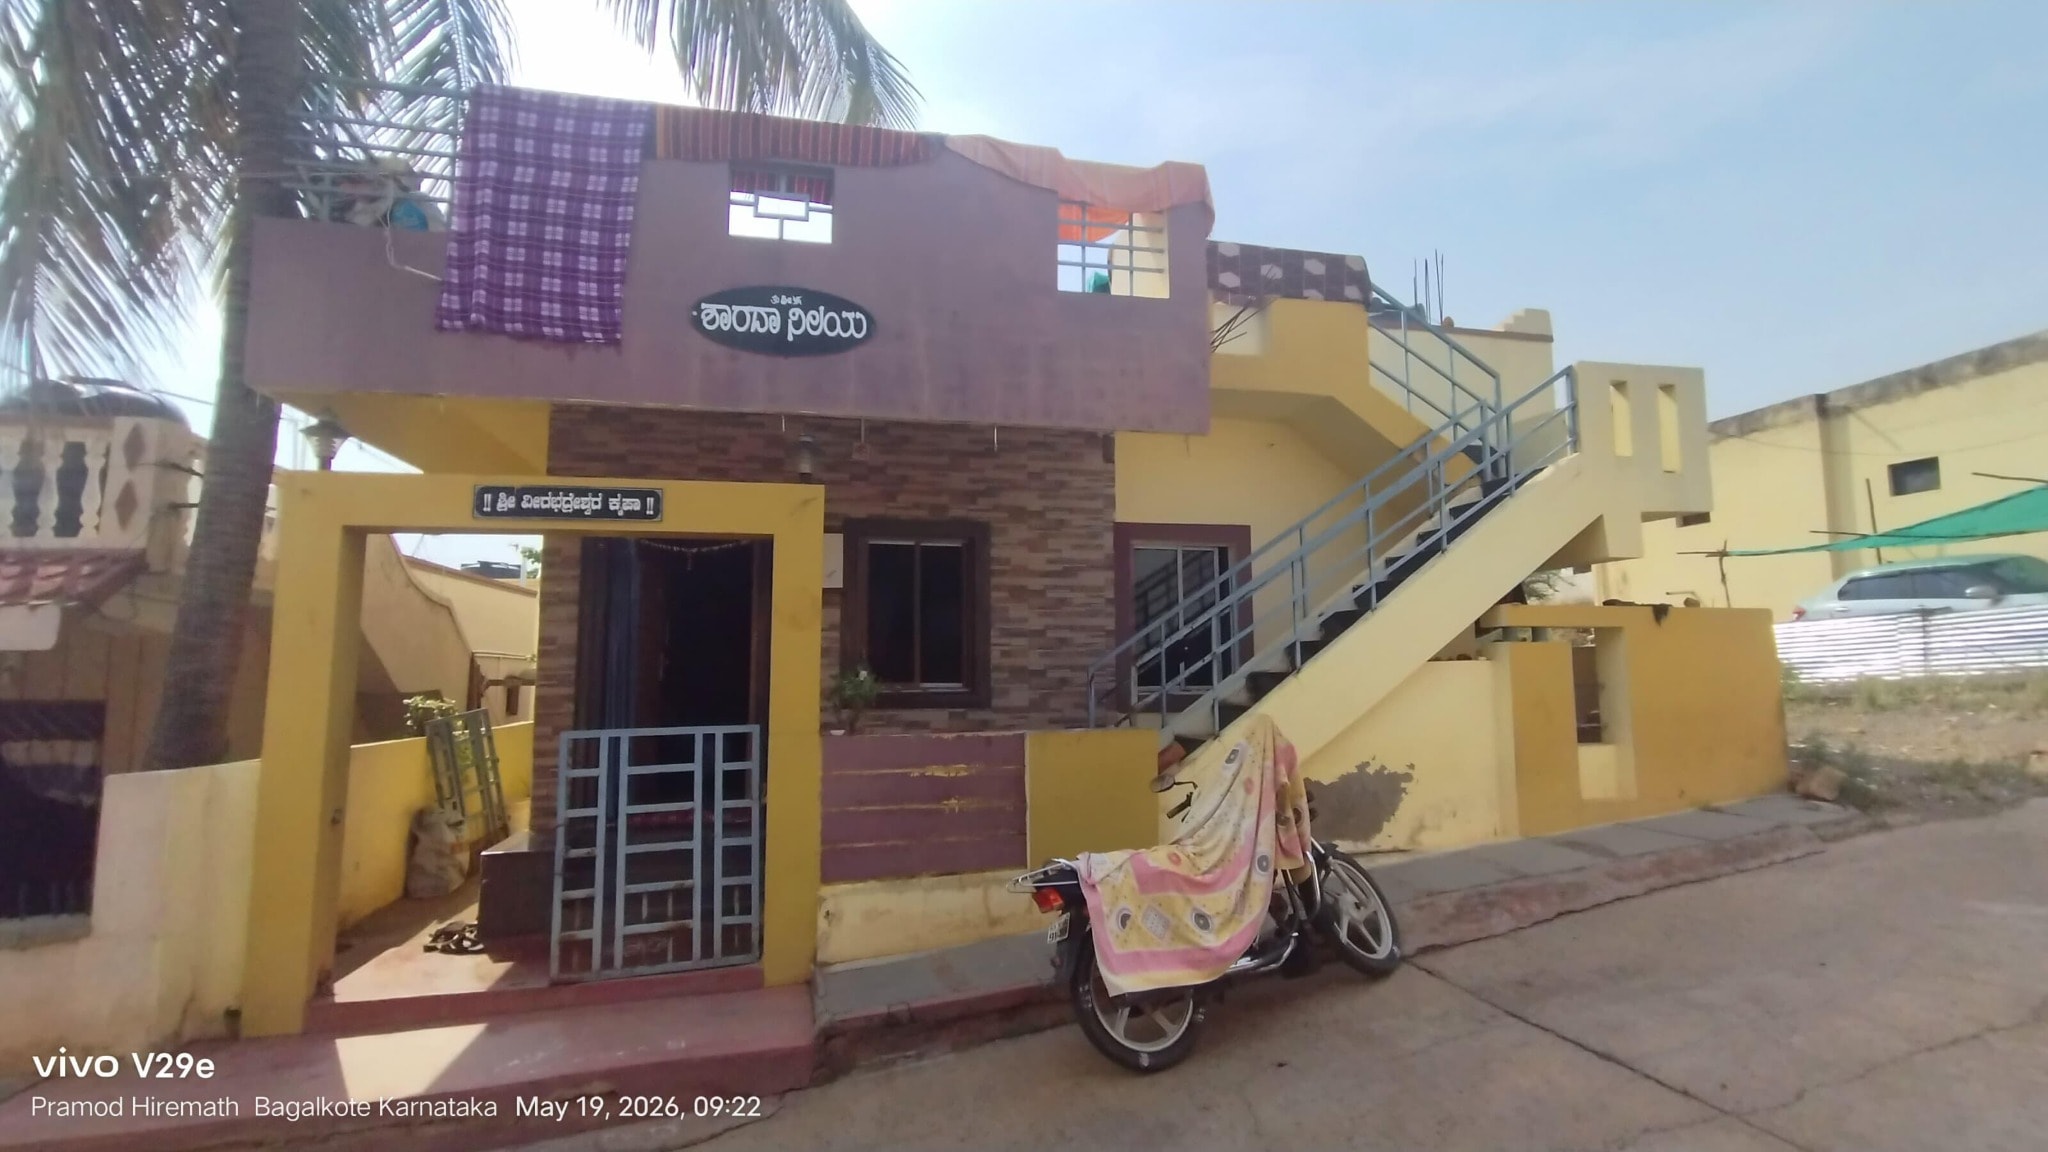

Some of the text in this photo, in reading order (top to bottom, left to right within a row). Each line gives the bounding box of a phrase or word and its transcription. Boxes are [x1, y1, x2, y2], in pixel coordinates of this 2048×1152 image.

[701, 303, 867, 341] ಶಾರದಾ ನಿಲಯ
[496, 492, 516, 512] ಶ್ರೀ
[521, 491, 602, 515] ವೀರಭದ್ರೇಶ್ವರ
[608, 493, 641, 516] ಕೃಪಾ
